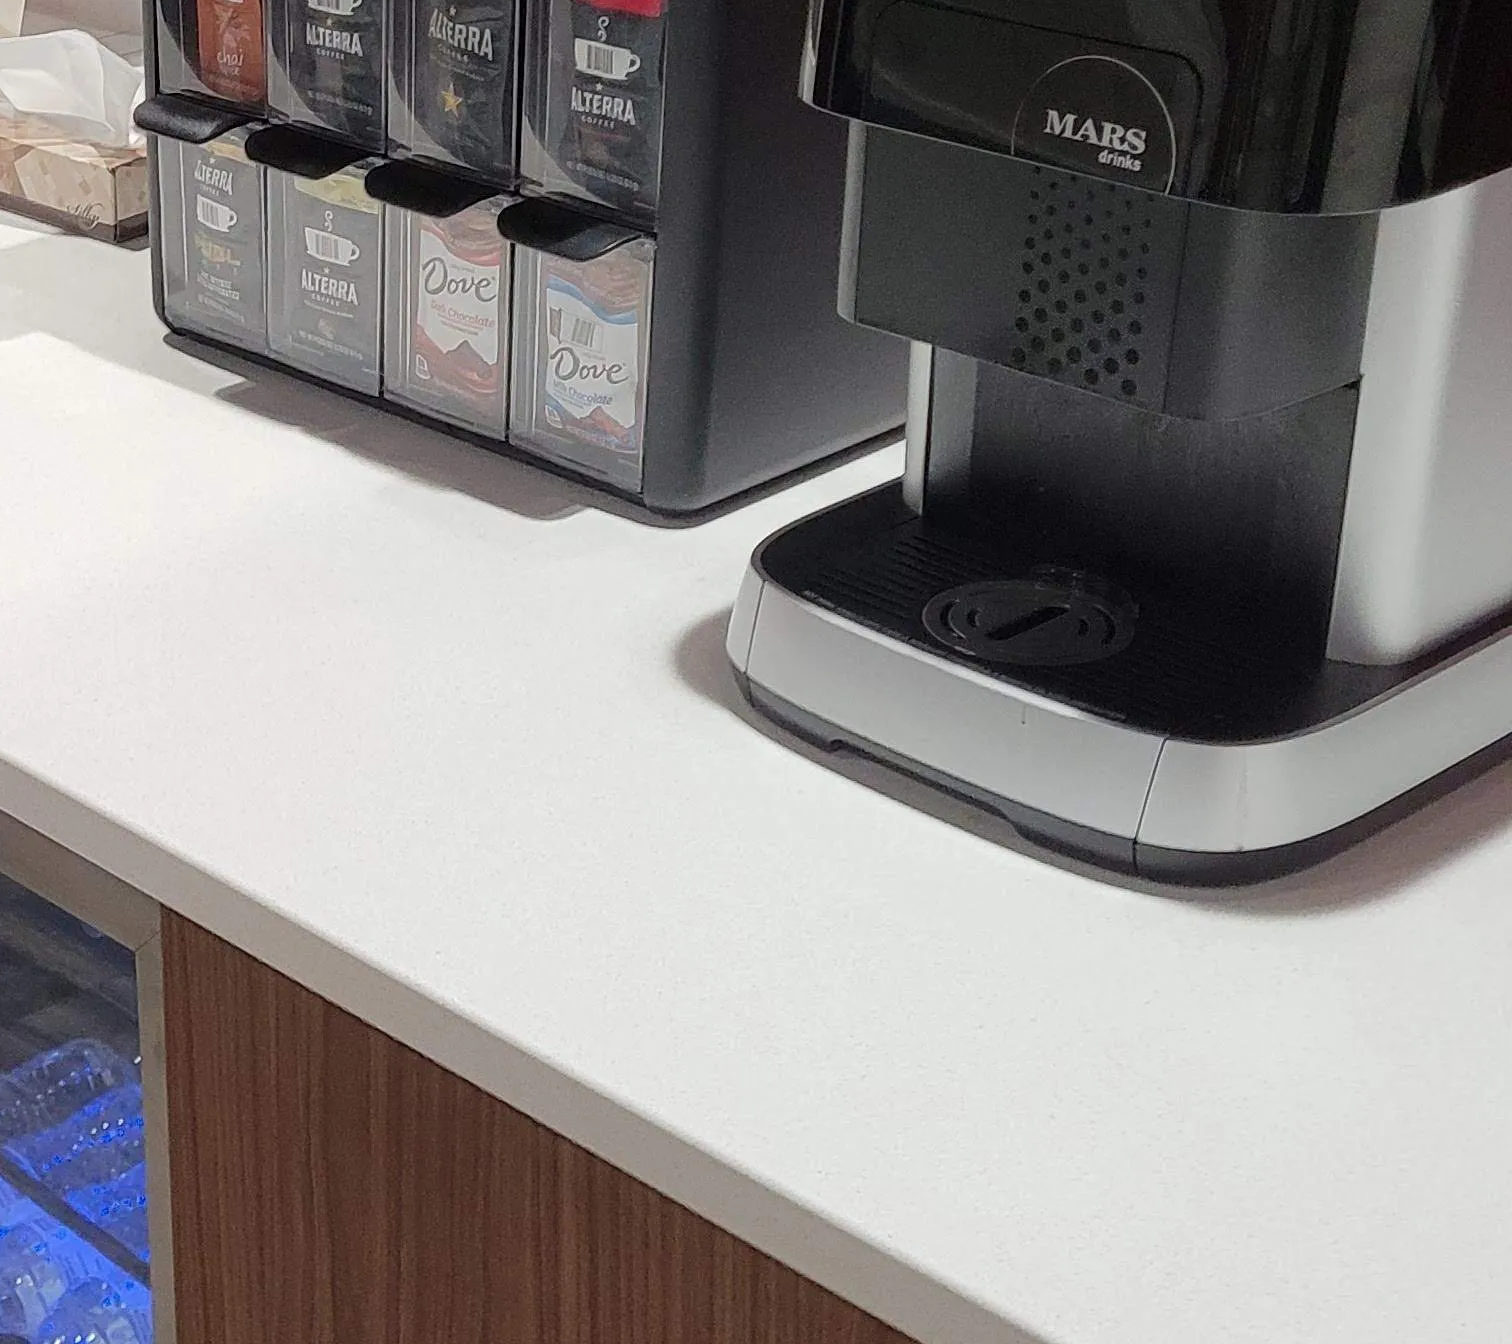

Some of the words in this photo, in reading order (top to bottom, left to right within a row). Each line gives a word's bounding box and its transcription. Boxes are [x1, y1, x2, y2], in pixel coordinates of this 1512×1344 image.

[306, 22, 364, 57] ALTERRA
[428, 8, 493, 62] ALTERRA
[570, 86, 636, 126] ALTERRA
[1043, 108, 1147, 154] MARS
[194, 159, 233, 195] ALTERRA
[1098, 149, 1142, 172] drinks
[301, 268, 358, 306] ALTERRA
[422, 257, 497, 302] Dove
[550, 346, 629, 385] Dove
